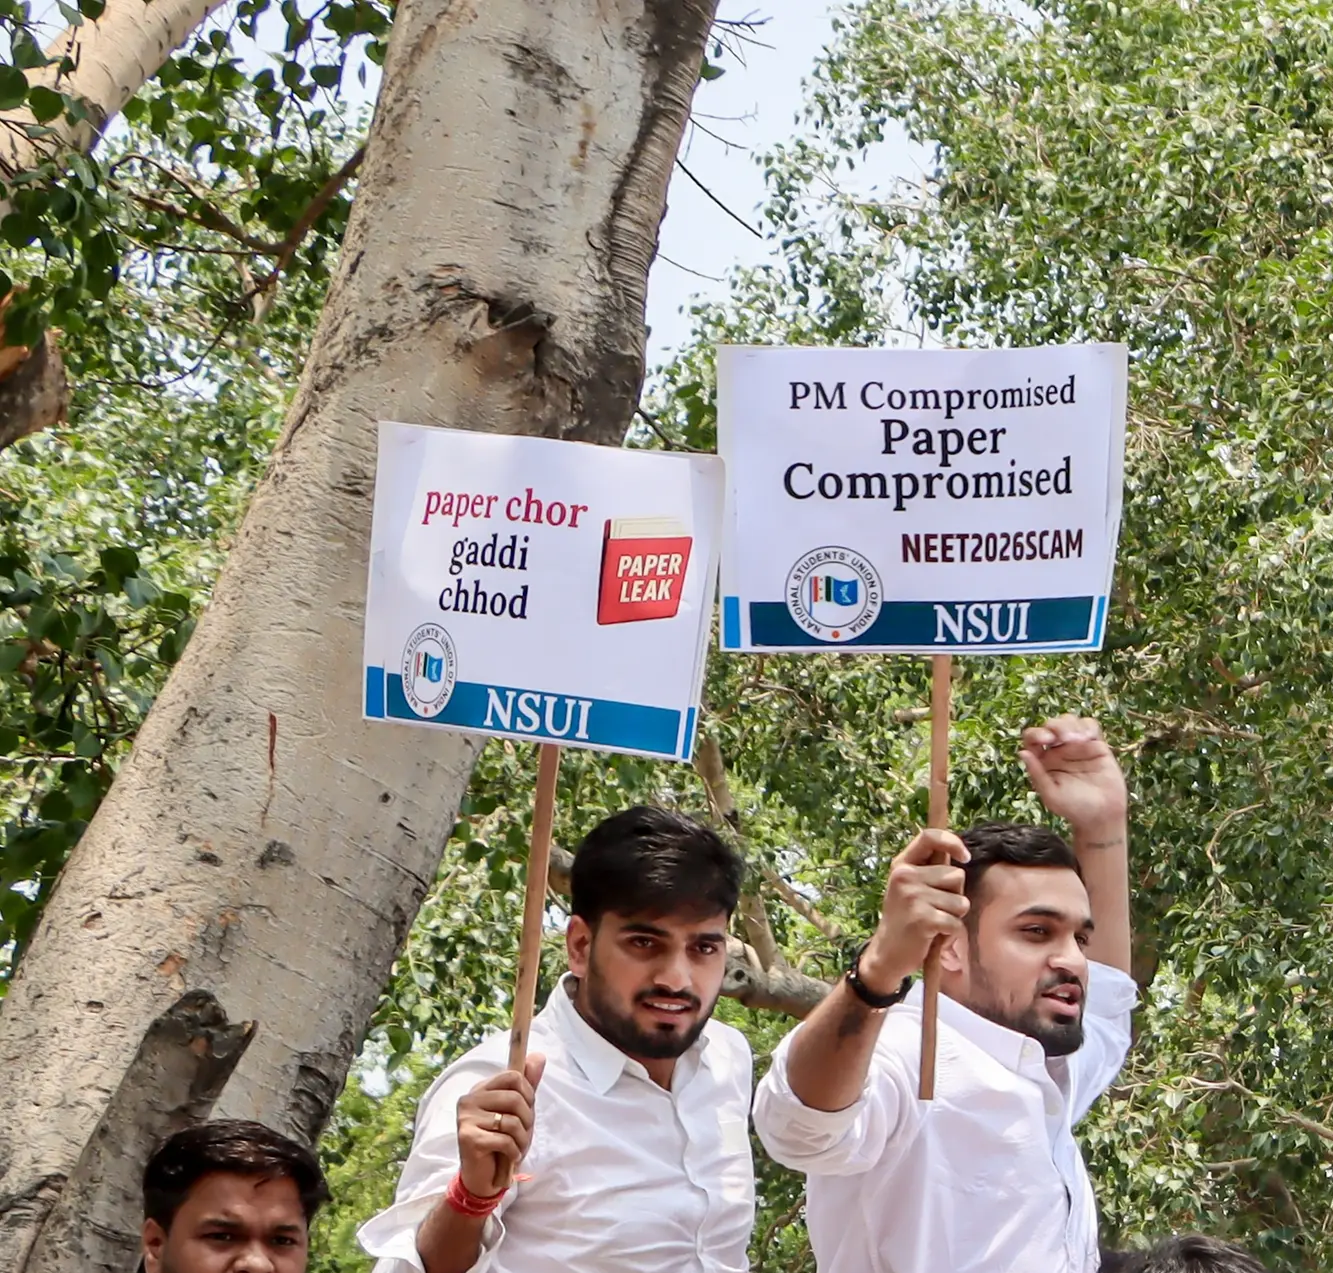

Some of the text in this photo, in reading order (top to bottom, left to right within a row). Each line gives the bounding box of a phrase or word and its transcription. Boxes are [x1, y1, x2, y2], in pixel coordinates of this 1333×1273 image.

[789, 374, 1076, 420] PM Compromised
[881, 418, 1008, 467] Paper
[783, 458, 1073, 511] Compromised
[421, 487, 589, 529] paper chor
[448, 532, 530, 576] gaddi
[617, 553, 683, 578] PAPER
[901, 528, 1083, 564] NEET2026SCAM
[619, 578, 674, 603] LEAK
[851, 557, 877, 589] UNION
[438, 578, 530, 620] chhod
[790, 585, 822, 634] NATIONAL
[870, 592, 879, 607] OF
[849, 609, 875, 634] INDIA
[933, 602, 1031, 644] NSUI
[441, 637, 454, 668] UNION
[404, 660, 418, 708] NATIONAL
[433, 686, 453, 711] INDIA
[447, 670, 453, 685] OF
[483, 687, 593, 740] NSUI
